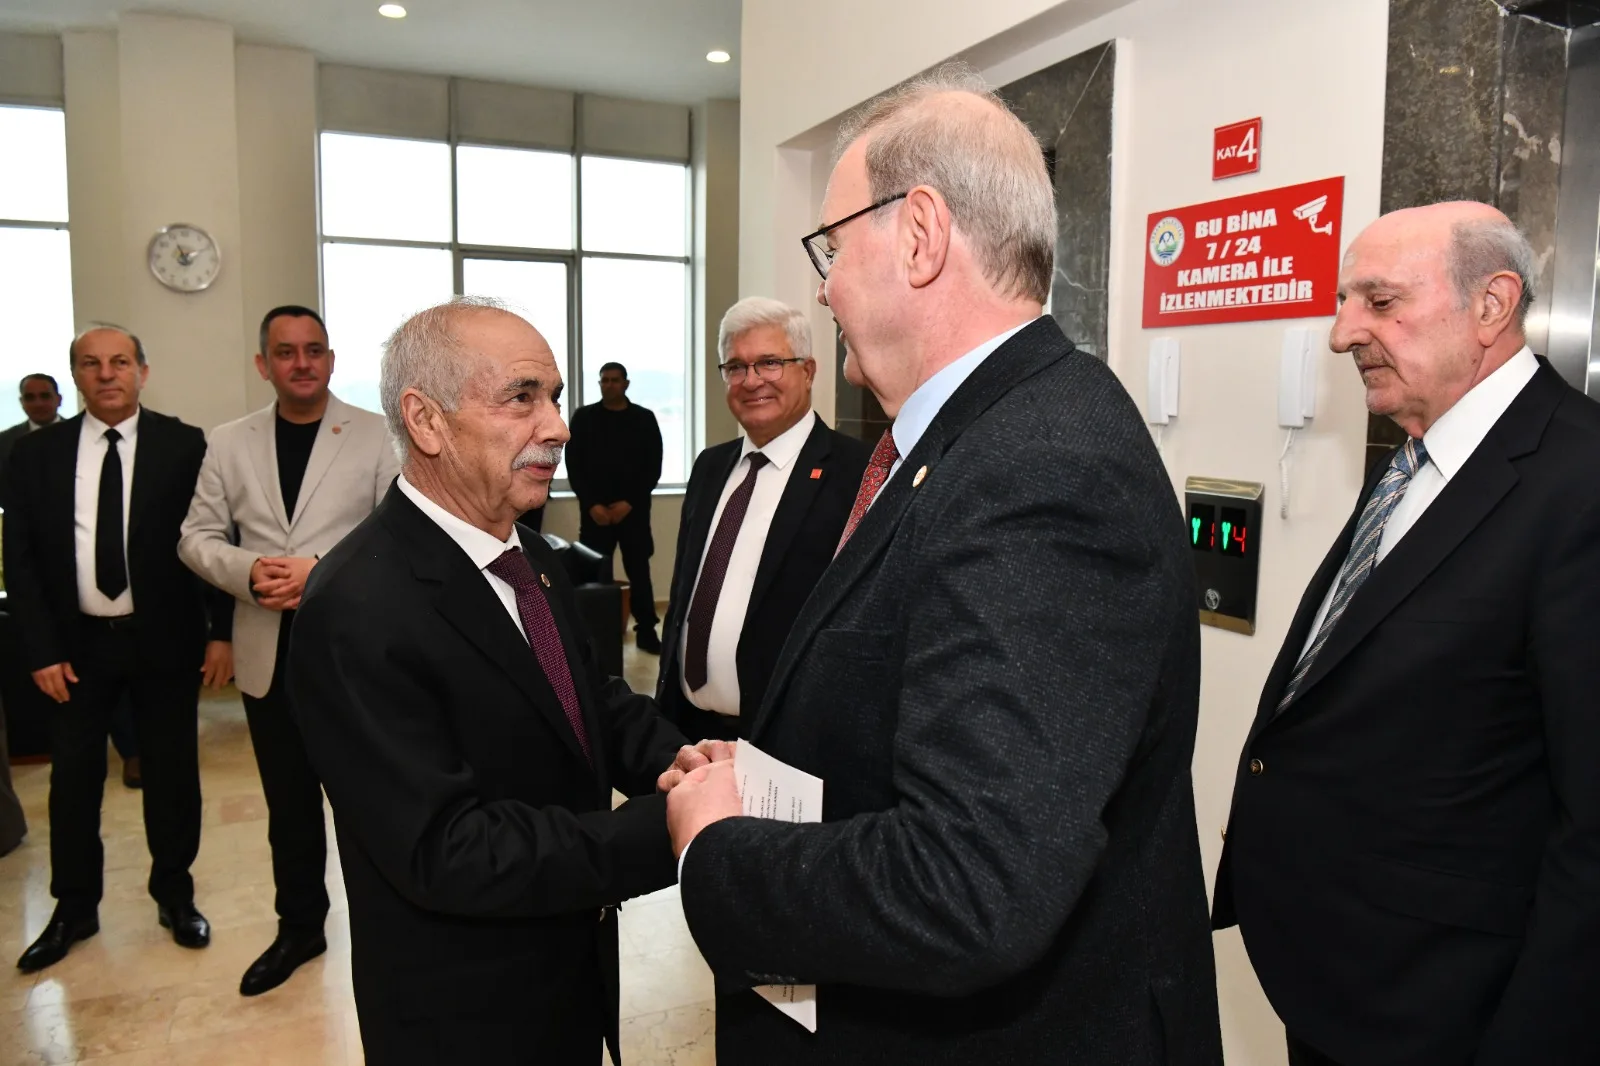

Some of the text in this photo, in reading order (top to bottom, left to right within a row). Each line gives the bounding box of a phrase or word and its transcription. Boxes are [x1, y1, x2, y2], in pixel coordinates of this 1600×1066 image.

[1216, 127, 1257, 163] KAT 4
[1195, 219, 1223, 239] BU
[1226, 207, 1278, 232] BİNA
[1206, 235, 1262, 261] 7 / 24
[1177, 255, 1294, 288] KAMERA İLE
[1160, 278, 1312, 311] İZLENMEKTEDİR
[1233, 525, 1246, 553] 4
